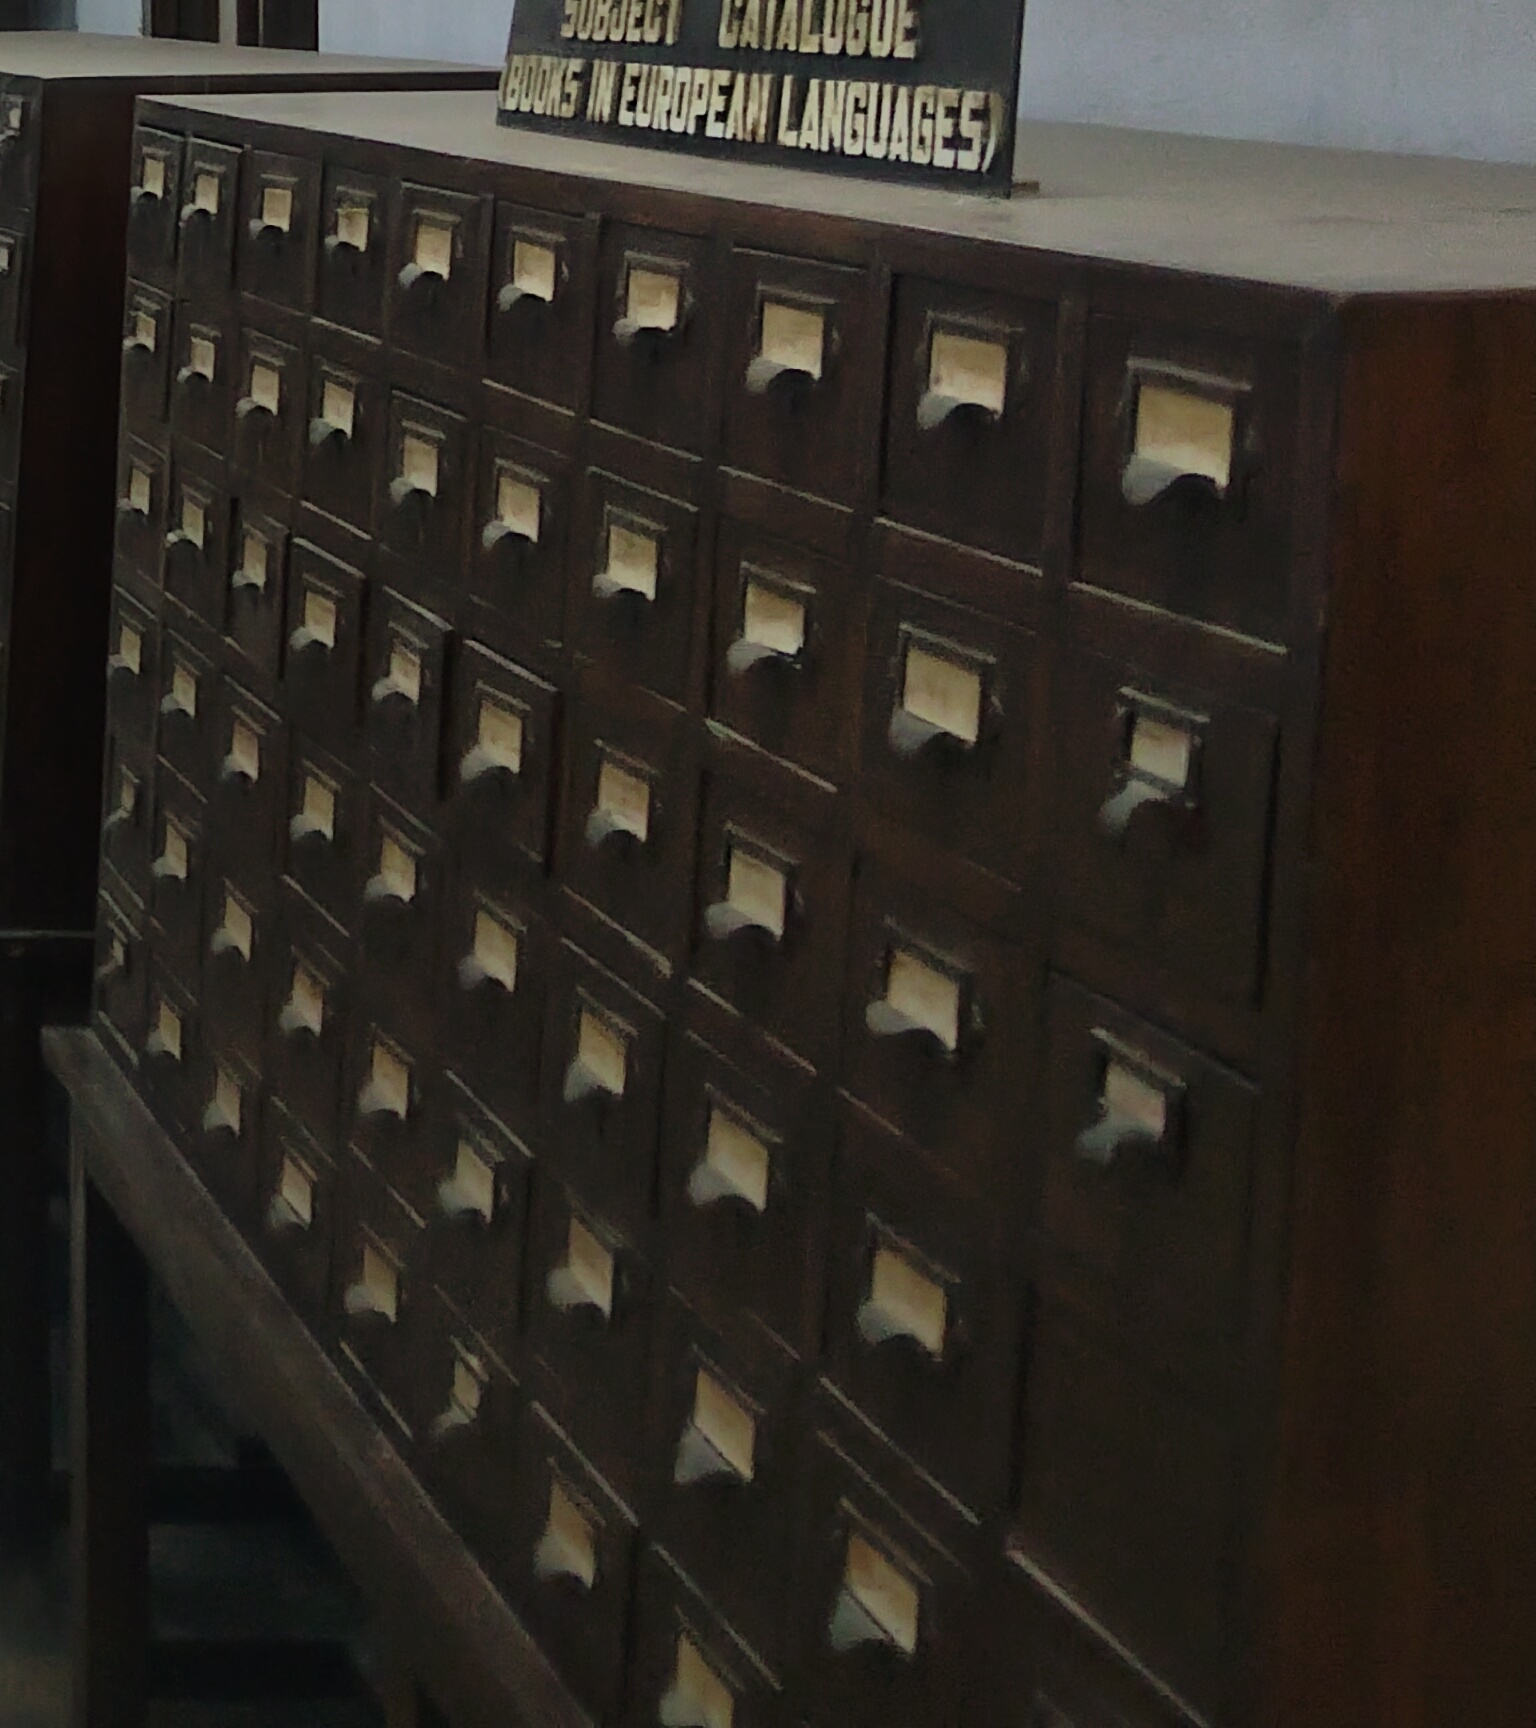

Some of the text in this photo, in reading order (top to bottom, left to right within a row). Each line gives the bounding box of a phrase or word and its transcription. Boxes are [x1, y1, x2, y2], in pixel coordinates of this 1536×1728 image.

[585, 58, 618, 123] IN
[617, 62, 774, 144] EUROPEAN
[778, 74, 1006, 173] LANGUAGES)
